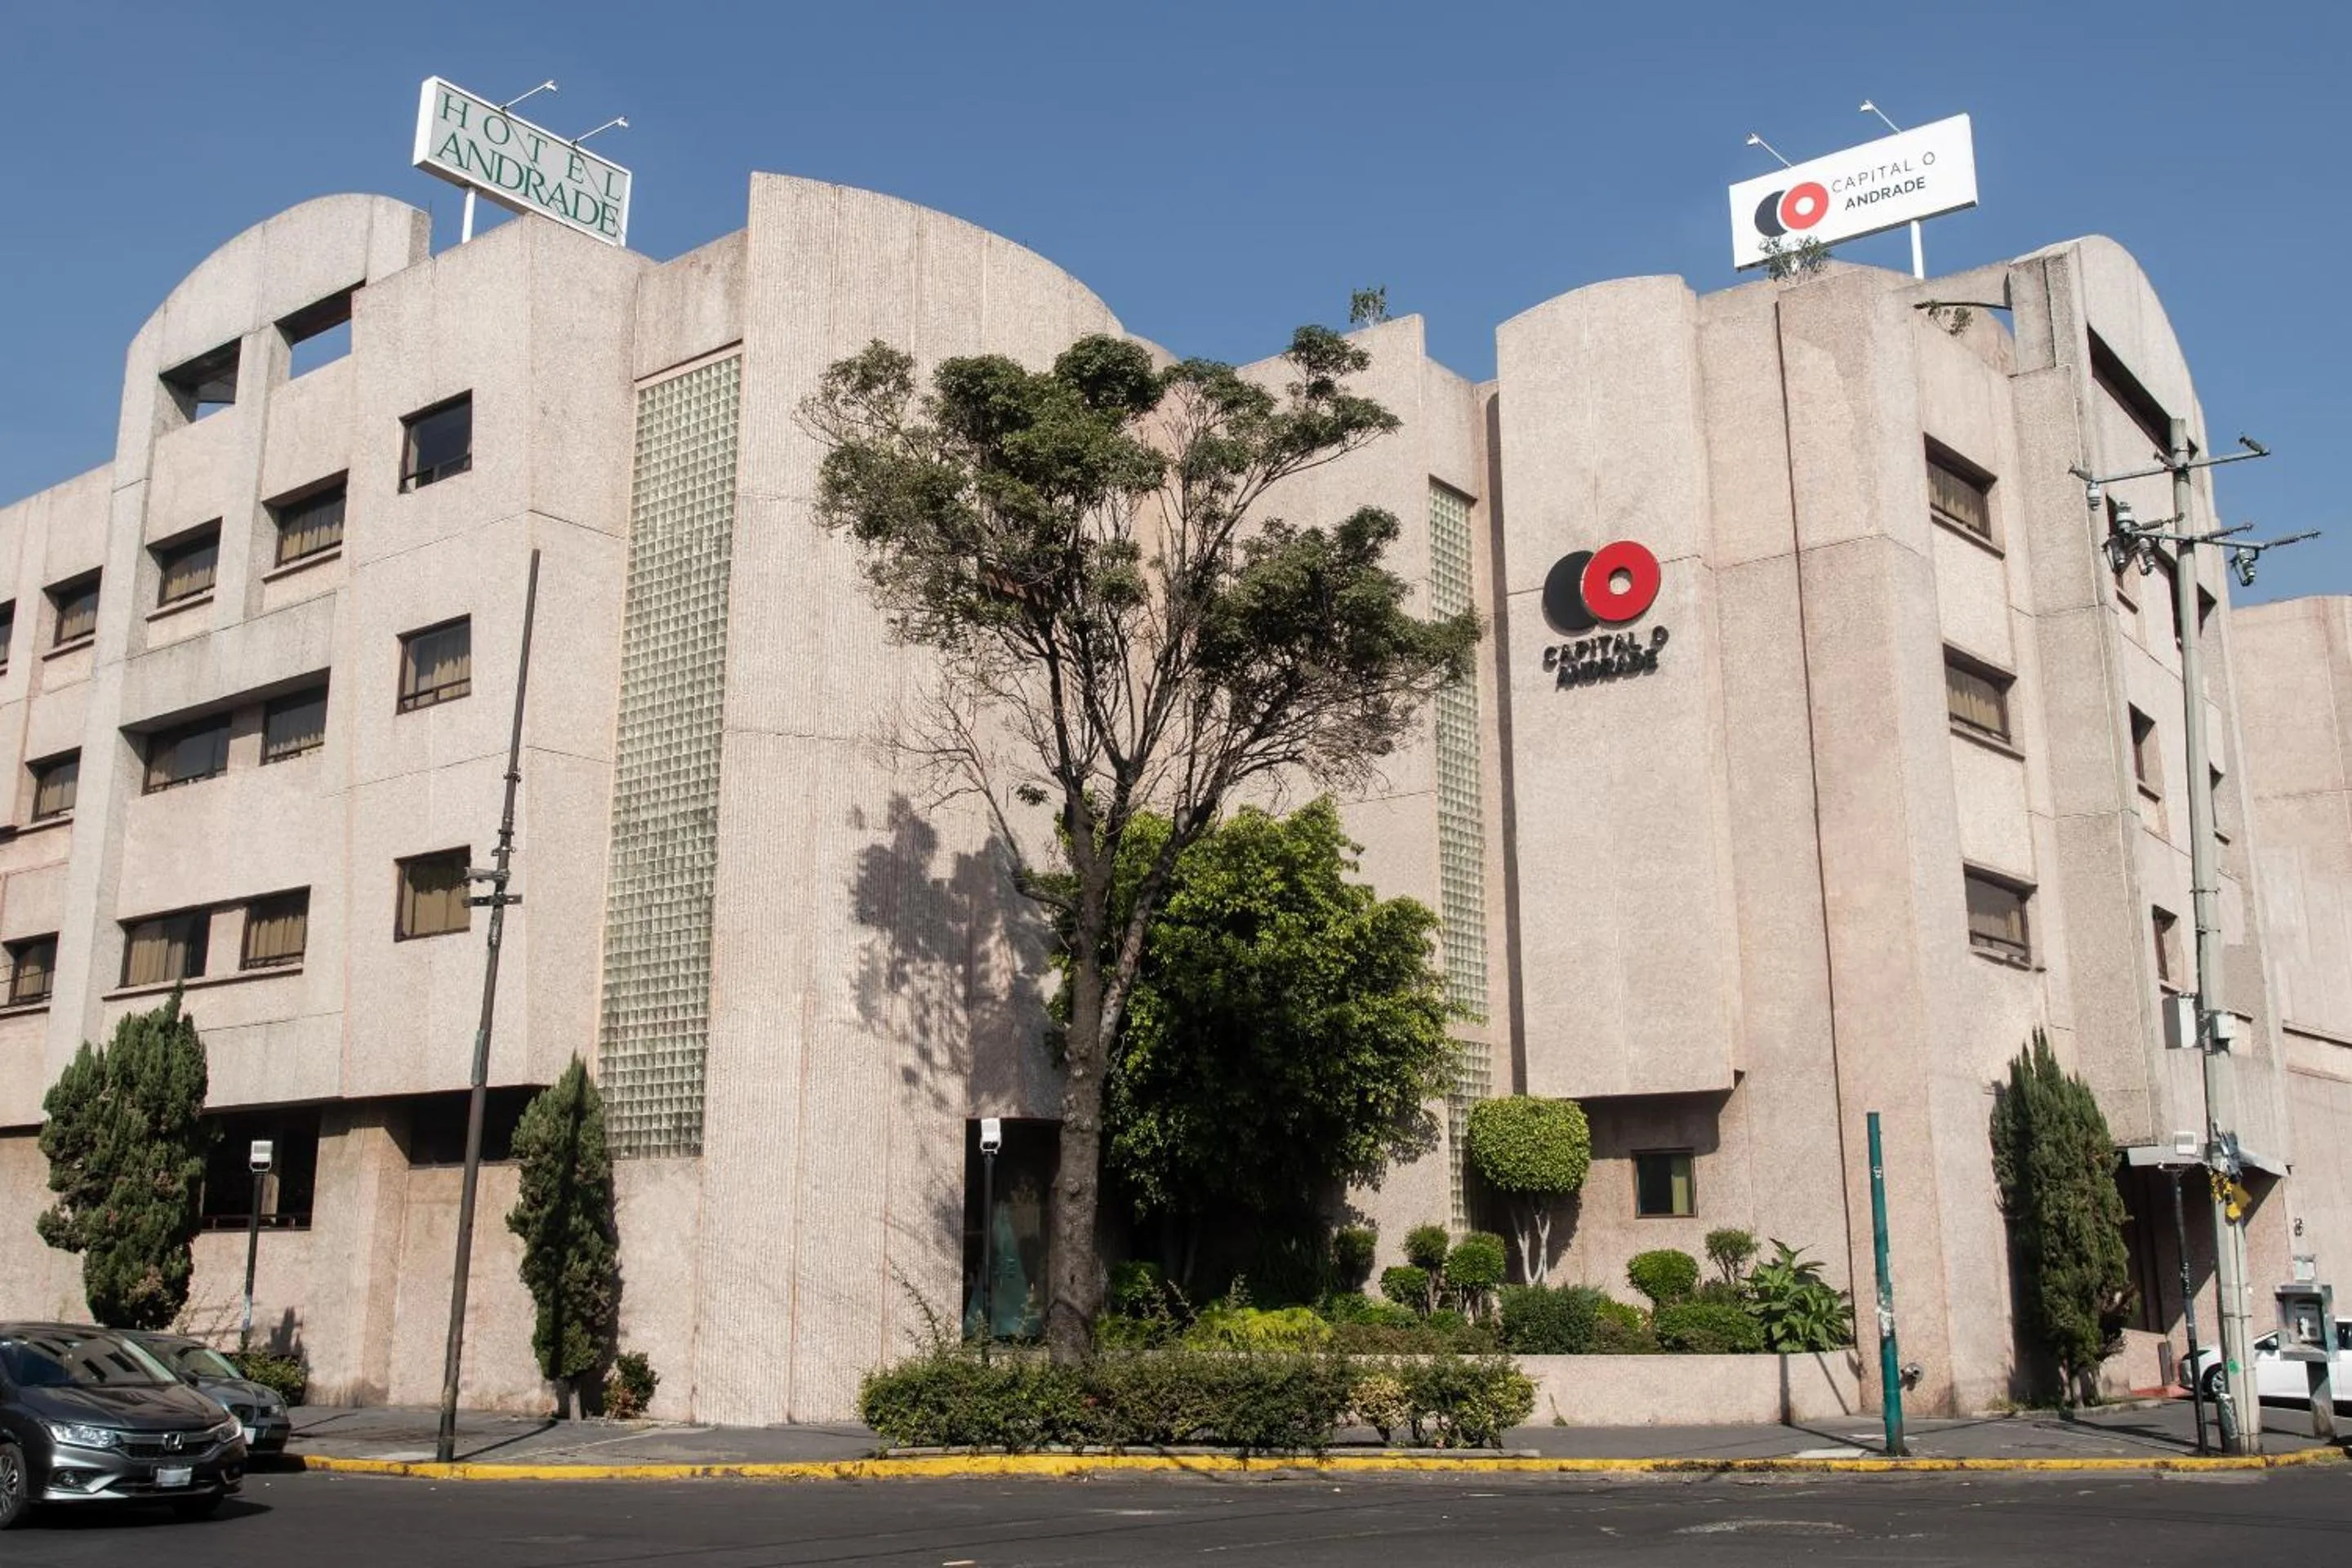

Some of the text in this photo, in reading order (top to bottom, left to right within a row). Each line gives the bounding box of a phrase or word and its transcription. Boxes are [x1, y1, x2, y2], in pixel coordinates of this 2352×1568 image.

[439, 91, 621, 202] HOTEL
[438, 131, 620, 238] ANDRADE
[1832, 152, 1936, 193] CAPITAL O
[1845, 176, 1926, 211] ANDRADE
[1543, 631, 1642, 670] CAPITAL
